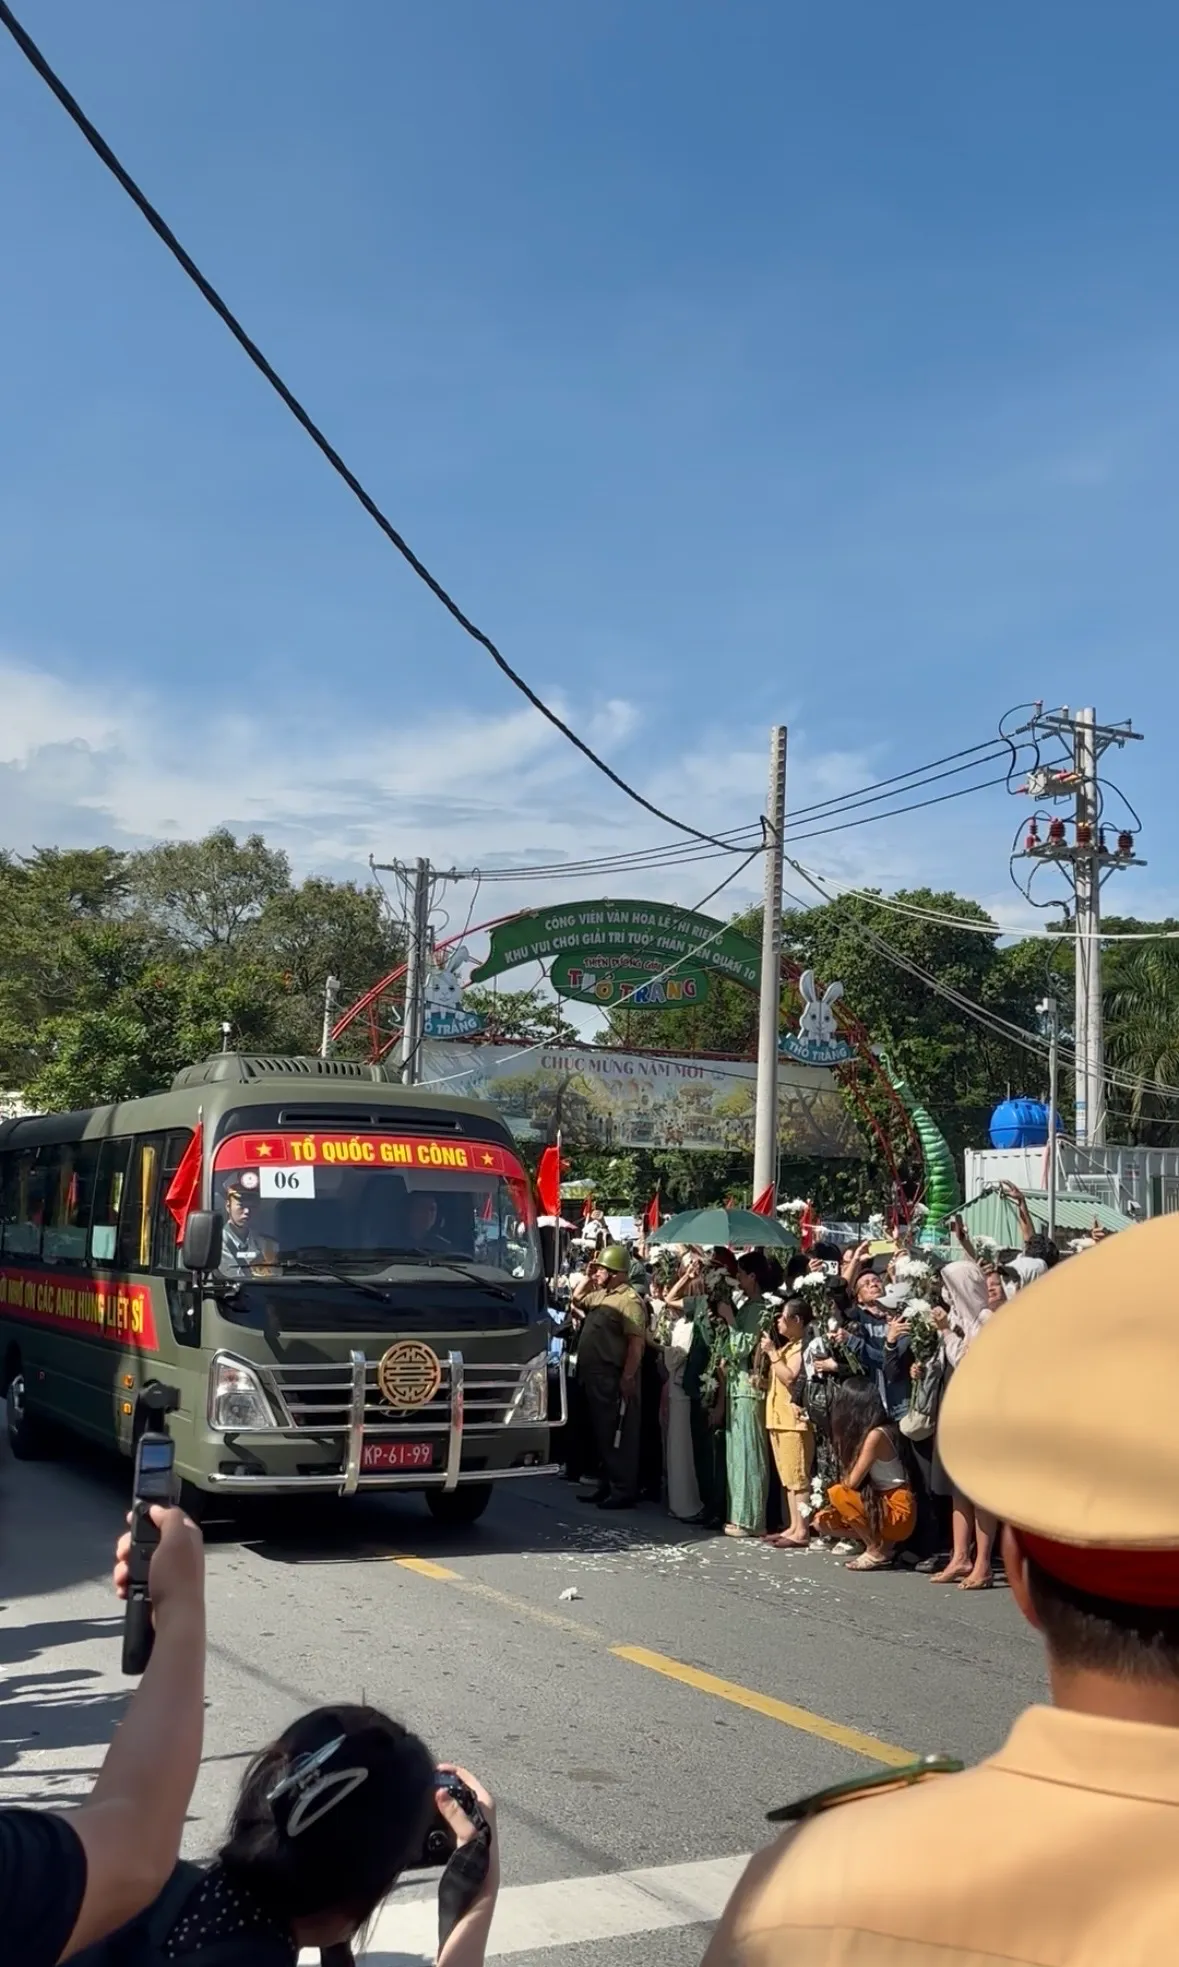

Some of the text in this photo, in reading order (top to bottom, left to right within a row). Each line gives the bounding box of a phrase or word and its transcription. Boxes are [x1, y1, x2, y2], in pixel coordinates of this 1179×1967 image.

[545, 914, 576, 931] CÔNG
[579, 909, 604, 925] VIÊN
[607, 909, 629, 924] VĂN
[504, 946, 529, 964] KHU
[531, 940, 551, 955] VUI
[553, 934, 579, 949] CHƠI
[582, 928, 605, 944] GIẢI
[609, 928, 625, 944] TRÍ
[712, 952, 743, 974] QUẬN
[743, 967, 756, 980] 10
[568, 968, 697, 1004] THỎ TRẮNG
[541, 1055, 585, 1071] CHÚC
[588, 1057, 634, 1075] MỪNG
[638, 1060, 670, 1077] NĂM
[290, 1134, 468, 1167] TỔ QUỐC GHI CÔNG
[274, 1171, 300, 1189] 06
[37, 1280, 54, 1313] CÁC
[55, 1287, 75, 1318] ANH
[77, 1284, 105, 1325] HÙNG
[106, 1289, 129, 1336] LIỆT
[131, 1293, 145, 1334] SĨ
[364, 1445, 430, 1465] KP-61-99
